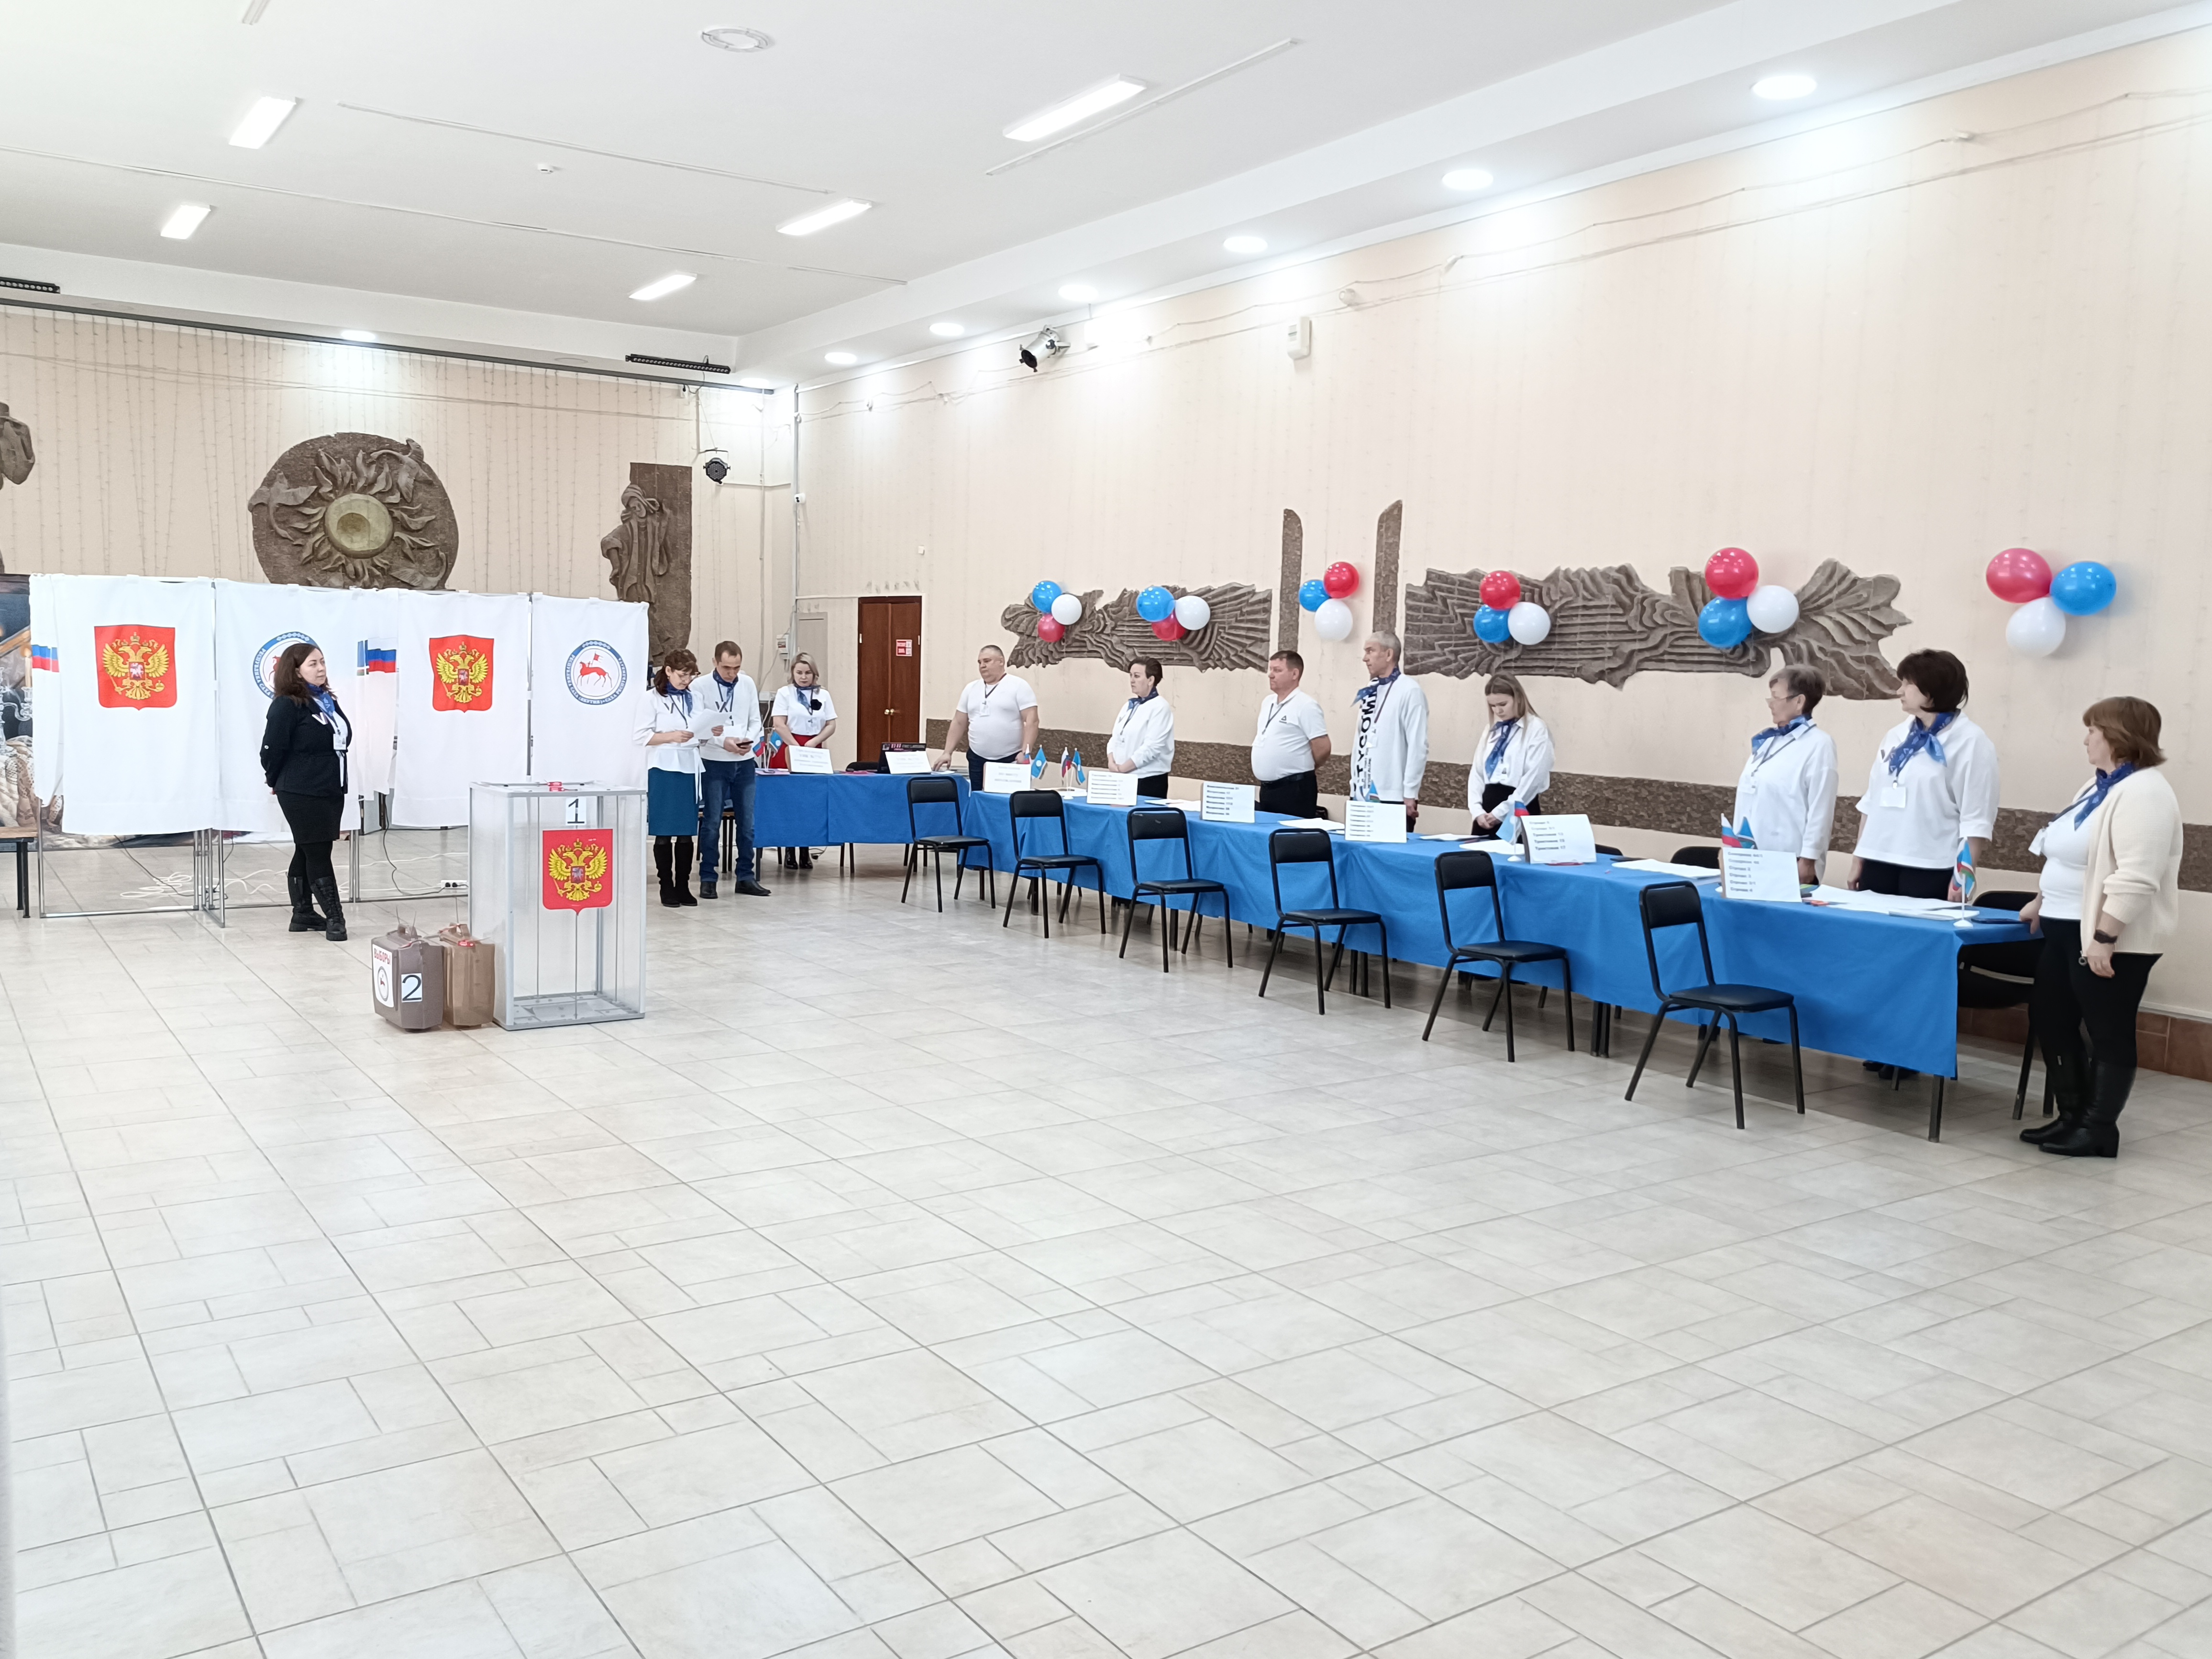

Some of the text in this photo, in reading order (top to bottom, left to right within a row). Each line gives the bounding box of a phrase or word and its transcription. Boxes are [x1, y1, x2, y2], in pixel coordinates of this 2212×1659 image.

[254, 648, 272, 696] РЕСПУБЛИКА САХА
[566, 654, 575, 686] РЕСПУБЛИКА
[570, 686, 578, 698] САХА
[605, 694, 617, 702] САХА
[567, 798, 585, 823] 1
[374, 948, 391, 965] ВЫБОРЫ
[402, 974, 421, 1001] 2
